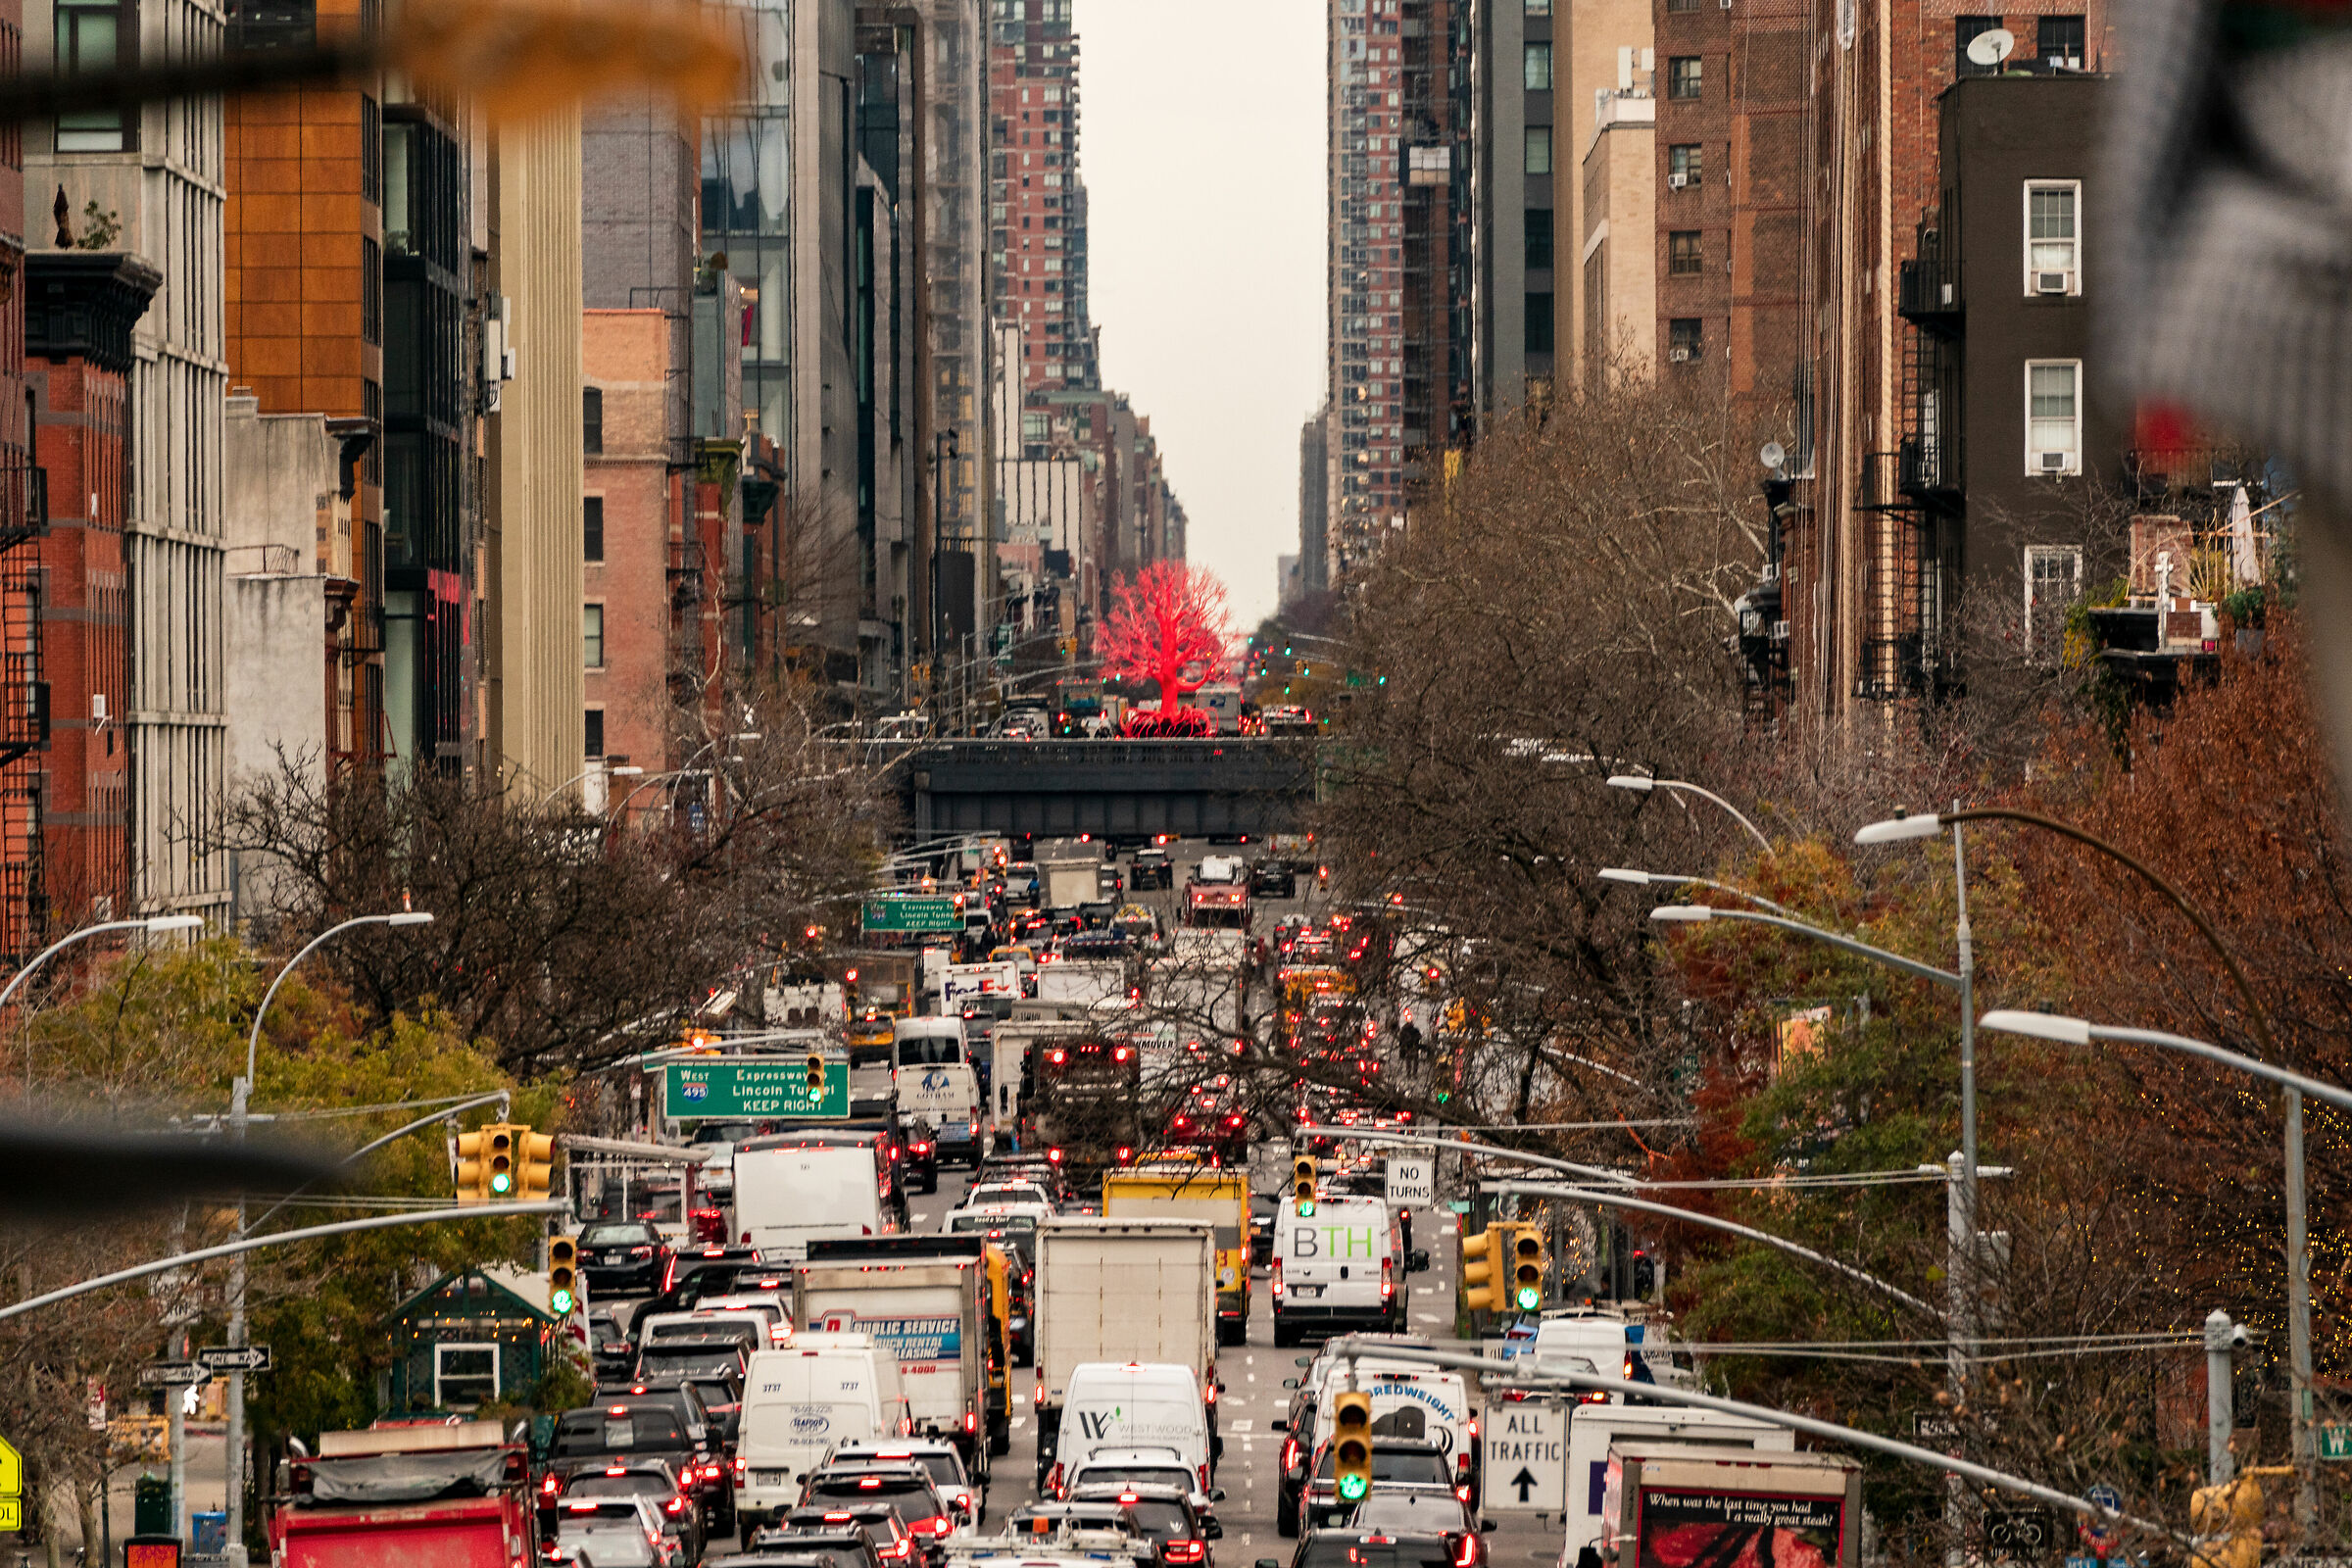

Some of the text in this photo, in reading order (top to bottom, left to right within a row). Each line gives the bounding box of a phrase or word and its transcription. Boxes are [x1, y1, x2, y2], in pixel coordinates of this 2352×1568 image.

[736, 1069, 808, 1083] Expressway
[683, 1088, 707, 1098] 495
[732, 1085, 783, 1097] Lincoln
[743, 1100, 822, 1112] KEEP RIGHT
[1399, 1167, 1419, 1180] NO
[1390, 1186, 1430, 1198] TURNS
[1294, 1227, 1372, 1257] BTH
[853, 1321, 902, 1336] PUBLIC
[903, 1319, 958, 1334] SERVICE
[905, 1337, 943, 1348] RENTAL
[238, 1352, 261, 1362] WAY
[896, 1348, 940, 1359] LEASING
[1507, 1414, 1544, 1434] ALL
[1490, 1441, 1560, 1461] TRAFFIC
[1648, 1493, 1811, 1516] When was the last time you had
[1734, 1509, 1834, 1527] a really great steak?
